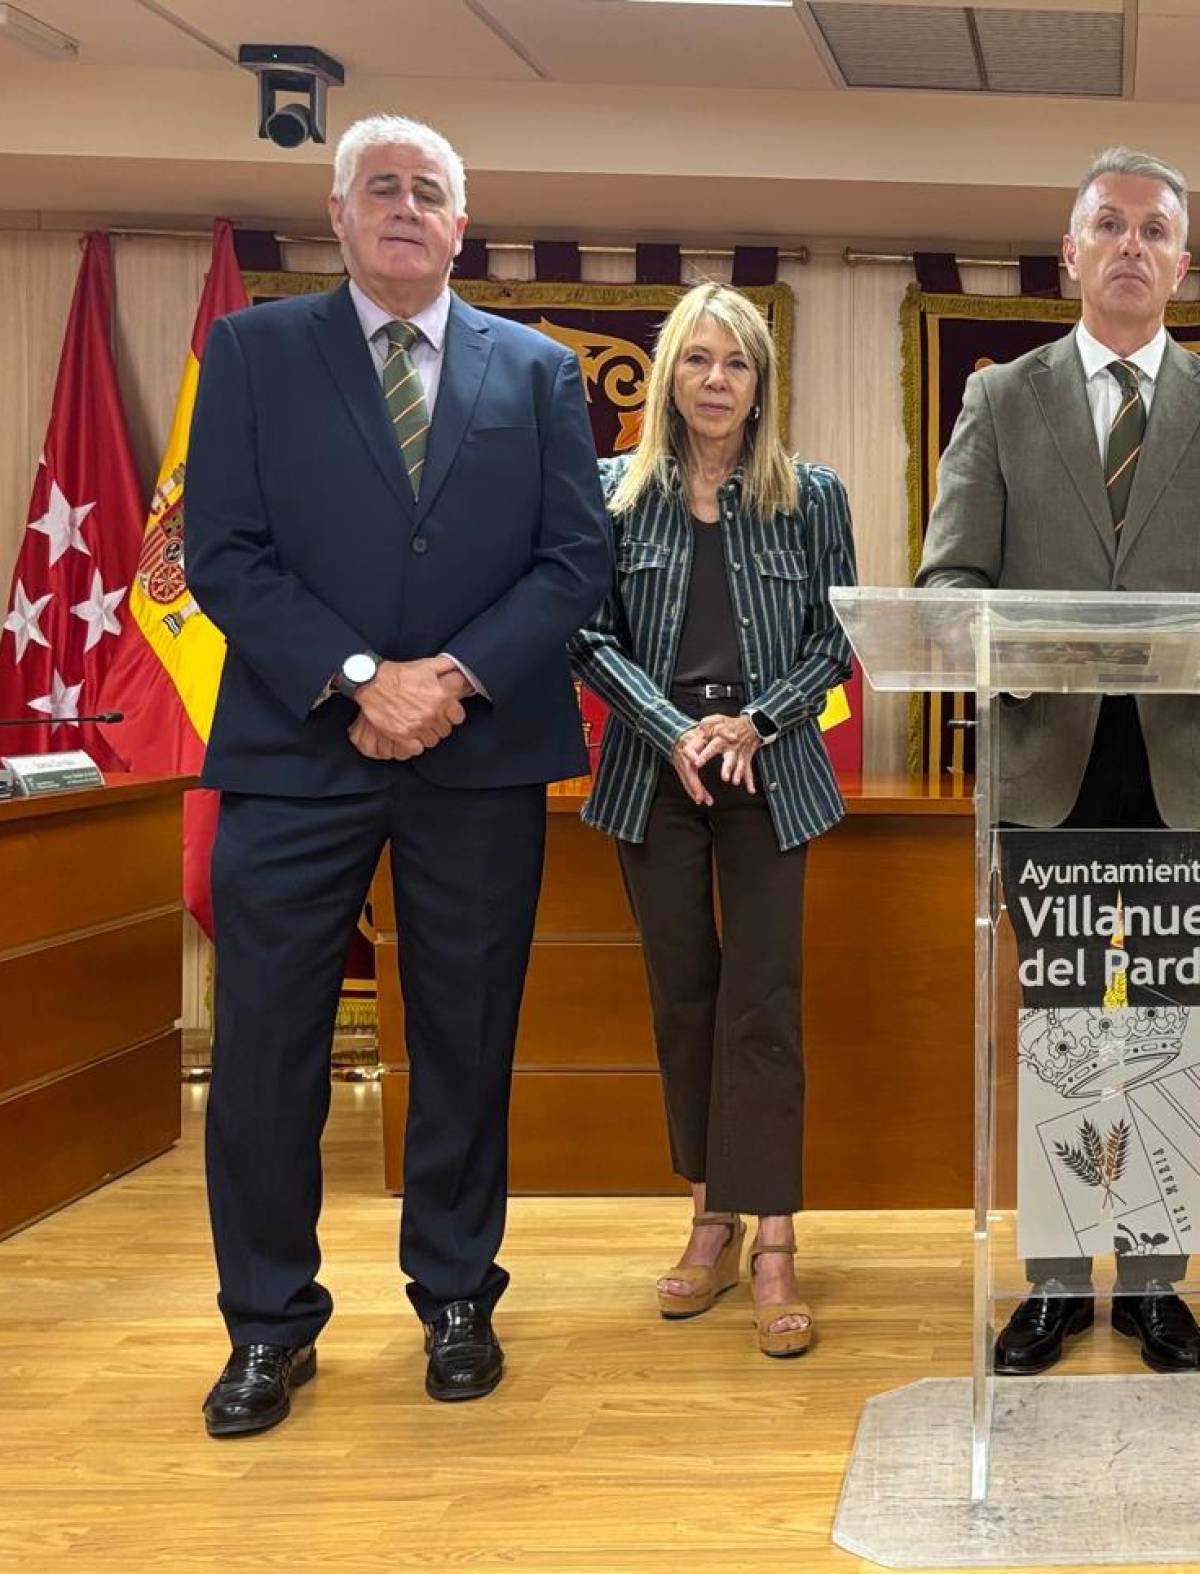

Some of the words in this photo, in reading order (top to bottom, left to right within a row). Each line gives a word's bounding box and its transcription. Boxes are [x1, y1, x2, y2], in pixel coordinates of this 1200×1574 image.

[1018, 947, 1087, 987] del
[1152, 1147, 1179, 1196] MARIA
[1173, 1205, 1193, 1233] AVE
